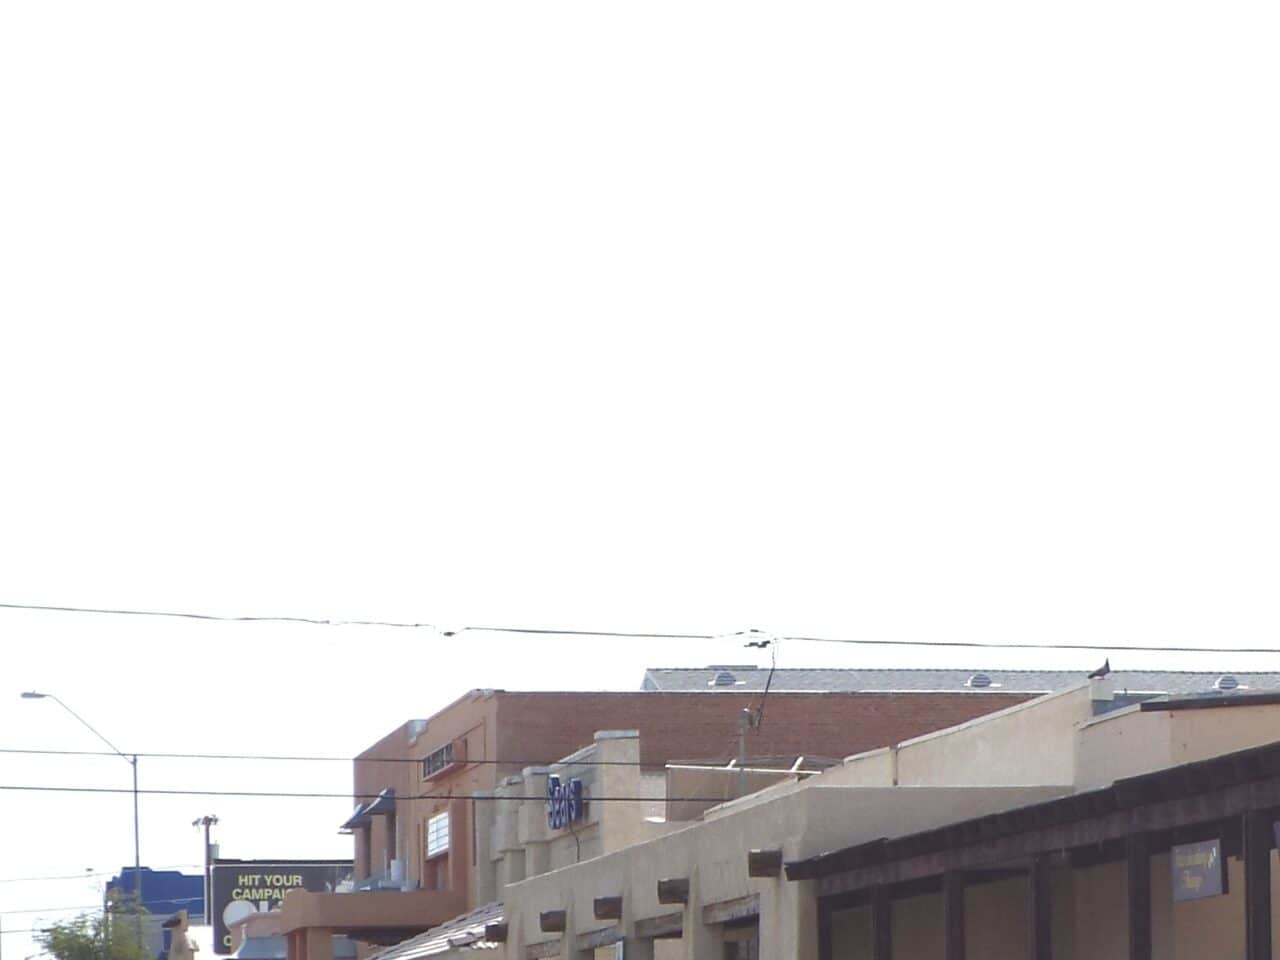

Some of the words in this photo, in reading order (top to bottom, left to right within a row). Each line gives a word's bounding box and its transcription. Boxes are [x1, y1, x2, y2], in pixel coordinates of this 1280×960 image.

[548, 777, 577, 828] Sears
[238, 875, 260, 886] HIT
[264, 875, 303, 886] YOUR
[231, 888, 290, 900] CAMPAI
